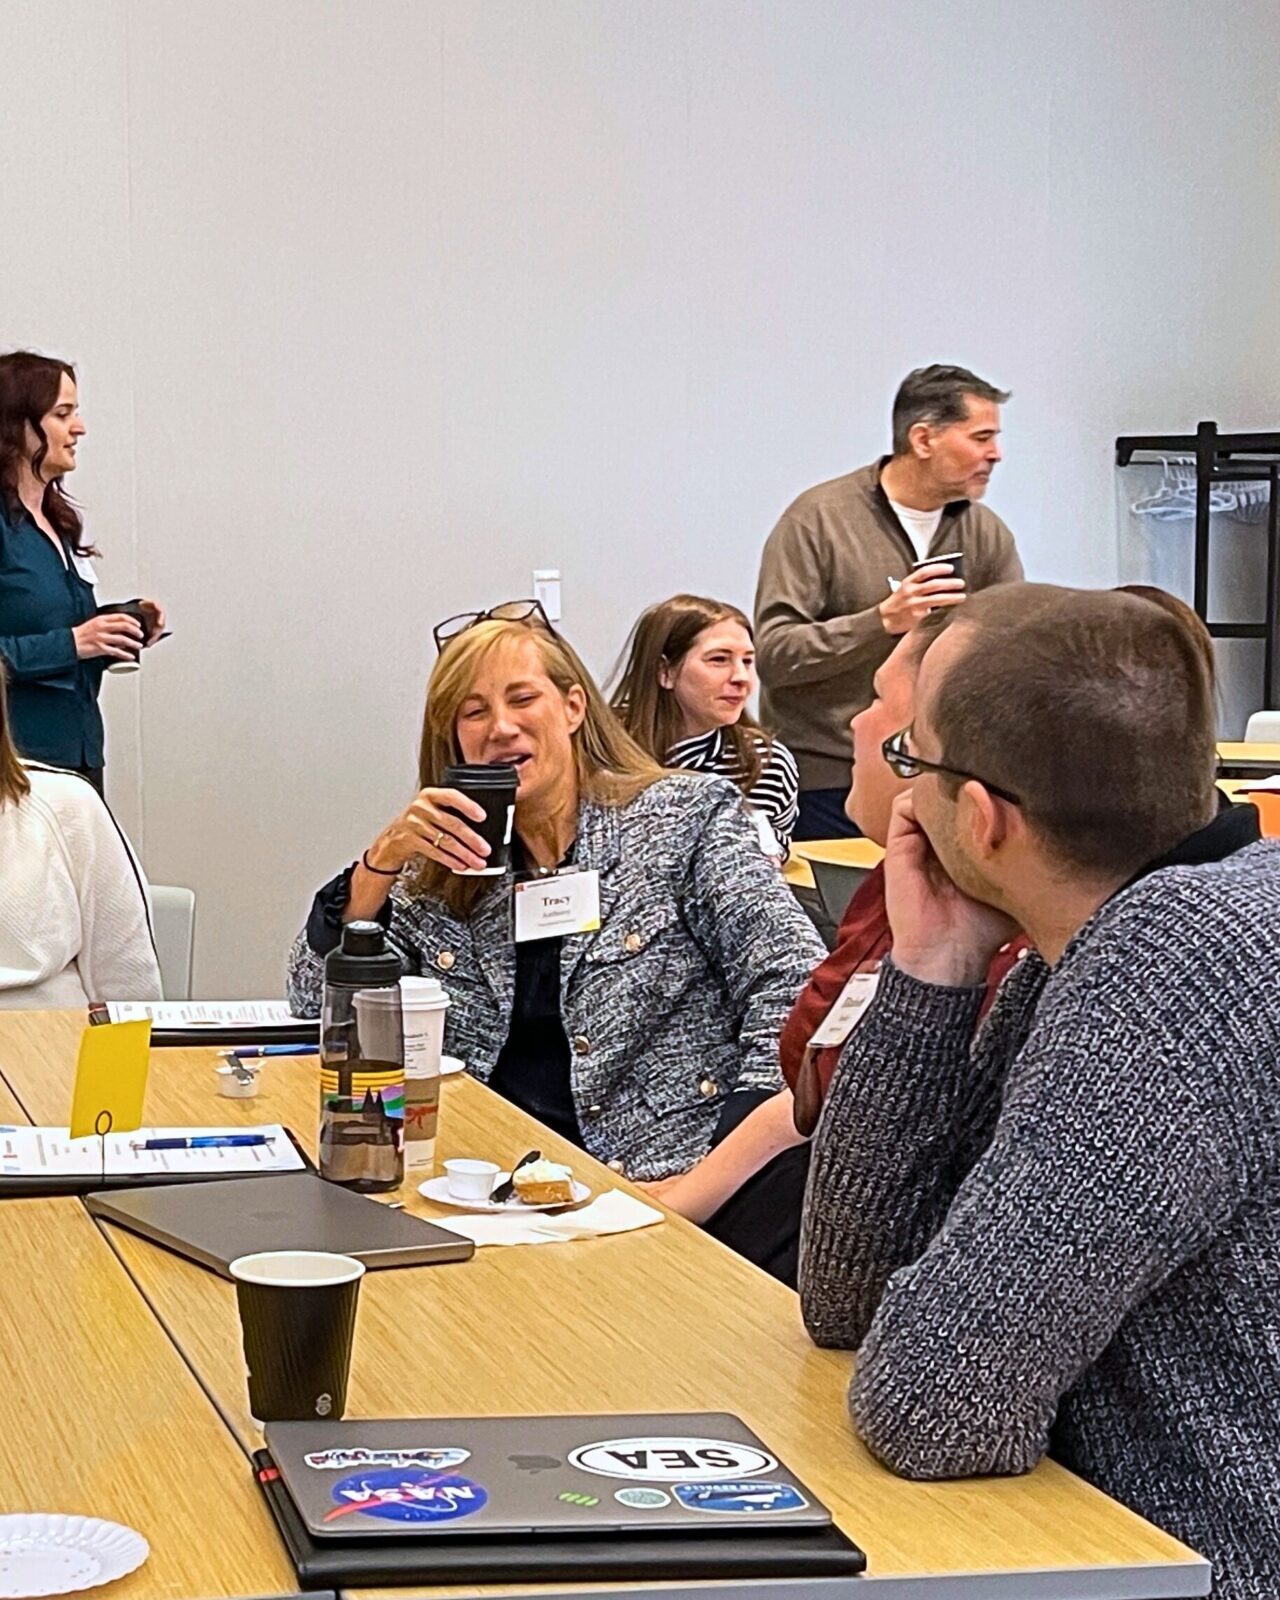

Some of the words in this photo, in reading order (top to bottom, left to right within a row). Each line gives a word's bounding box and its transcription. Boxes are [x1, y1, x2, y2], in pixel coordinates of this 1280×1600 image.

[541, 896, 570, 907] Tracy
[605, 1448, 740, 1470] SEA
[339, 1485, 476, 1502] NASA
